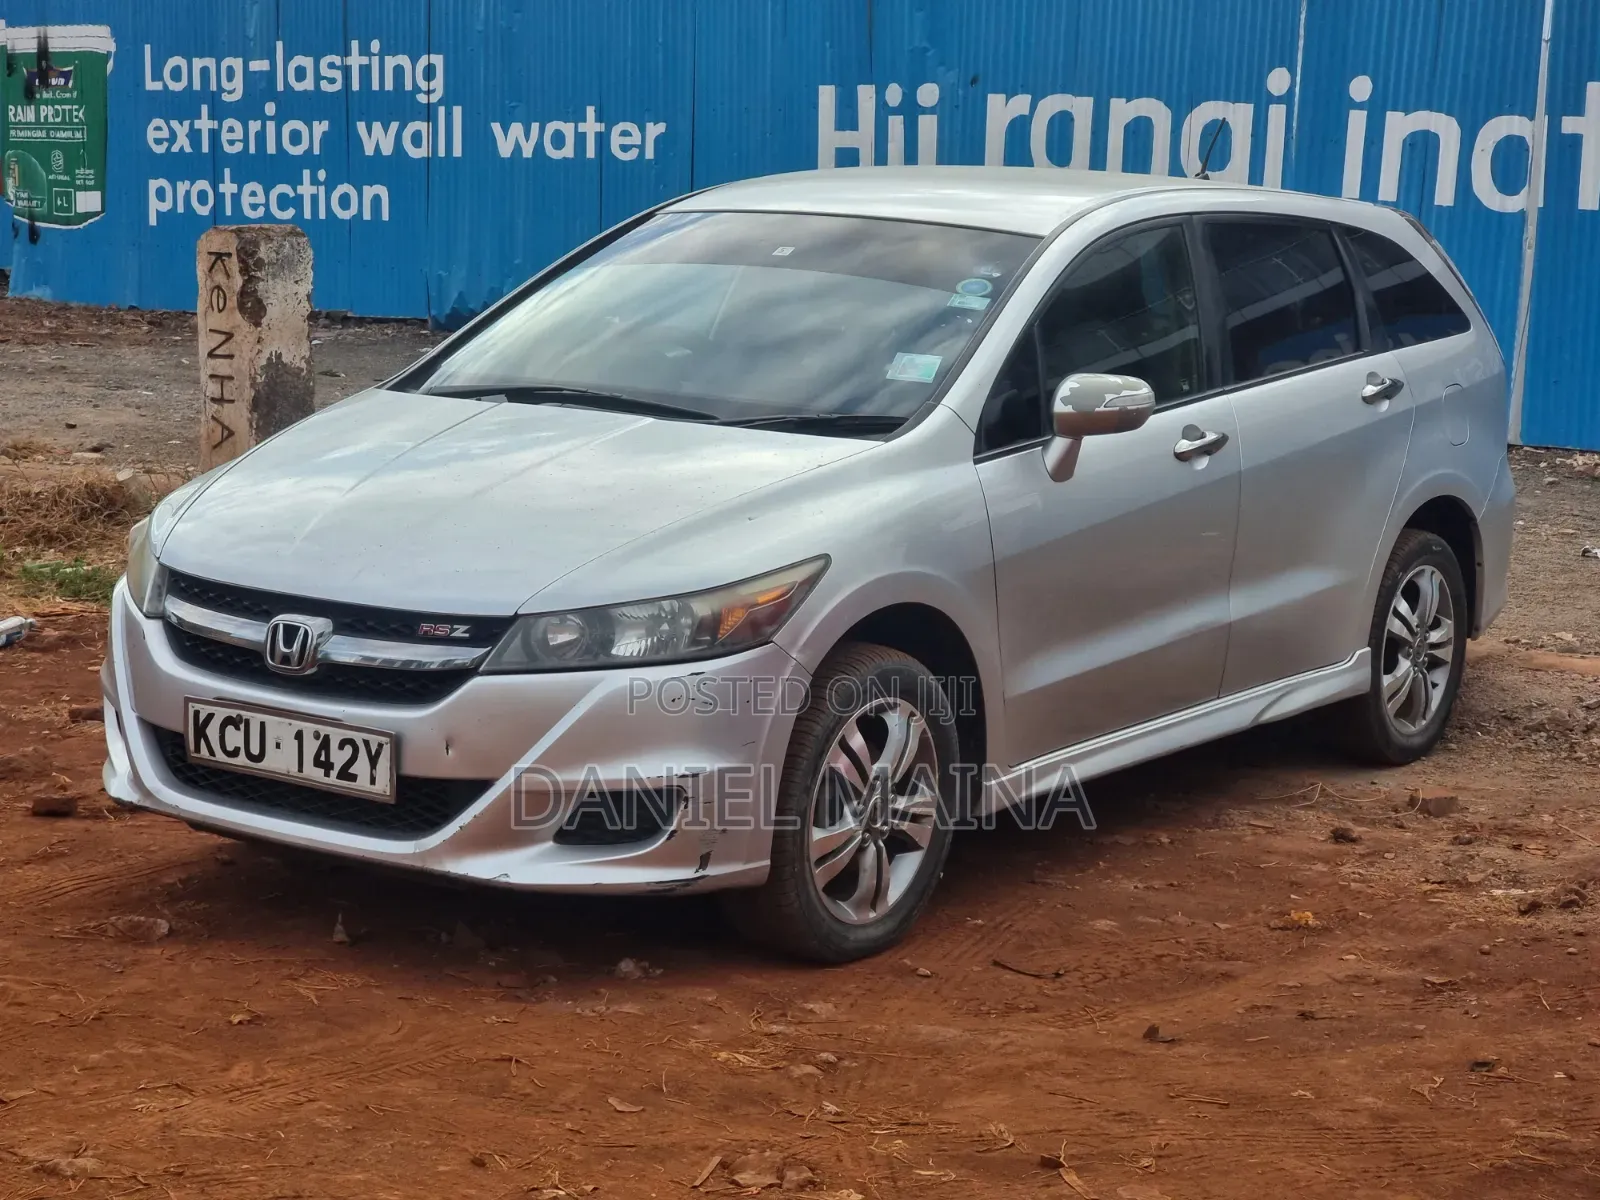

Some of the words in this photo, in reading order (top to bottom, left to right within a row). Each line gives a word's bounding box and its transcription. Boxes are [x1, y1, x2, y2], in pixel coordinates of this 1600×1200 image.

[144, 39, 444, 103] Long-lasting
[8, 105, 35, 122] RAIN
[147, 102, 328, 155] exterior
[357, 106, 462, 158] wall
[491, 106, 666, 161] water
[817, 82, 939, 166] Hii
[148, 168, 389, 226] protection
[418, 623, 471, 637] RSZ
[191, 709, 266, 764] KCU
[294, 729, 385, 786] 142Y
